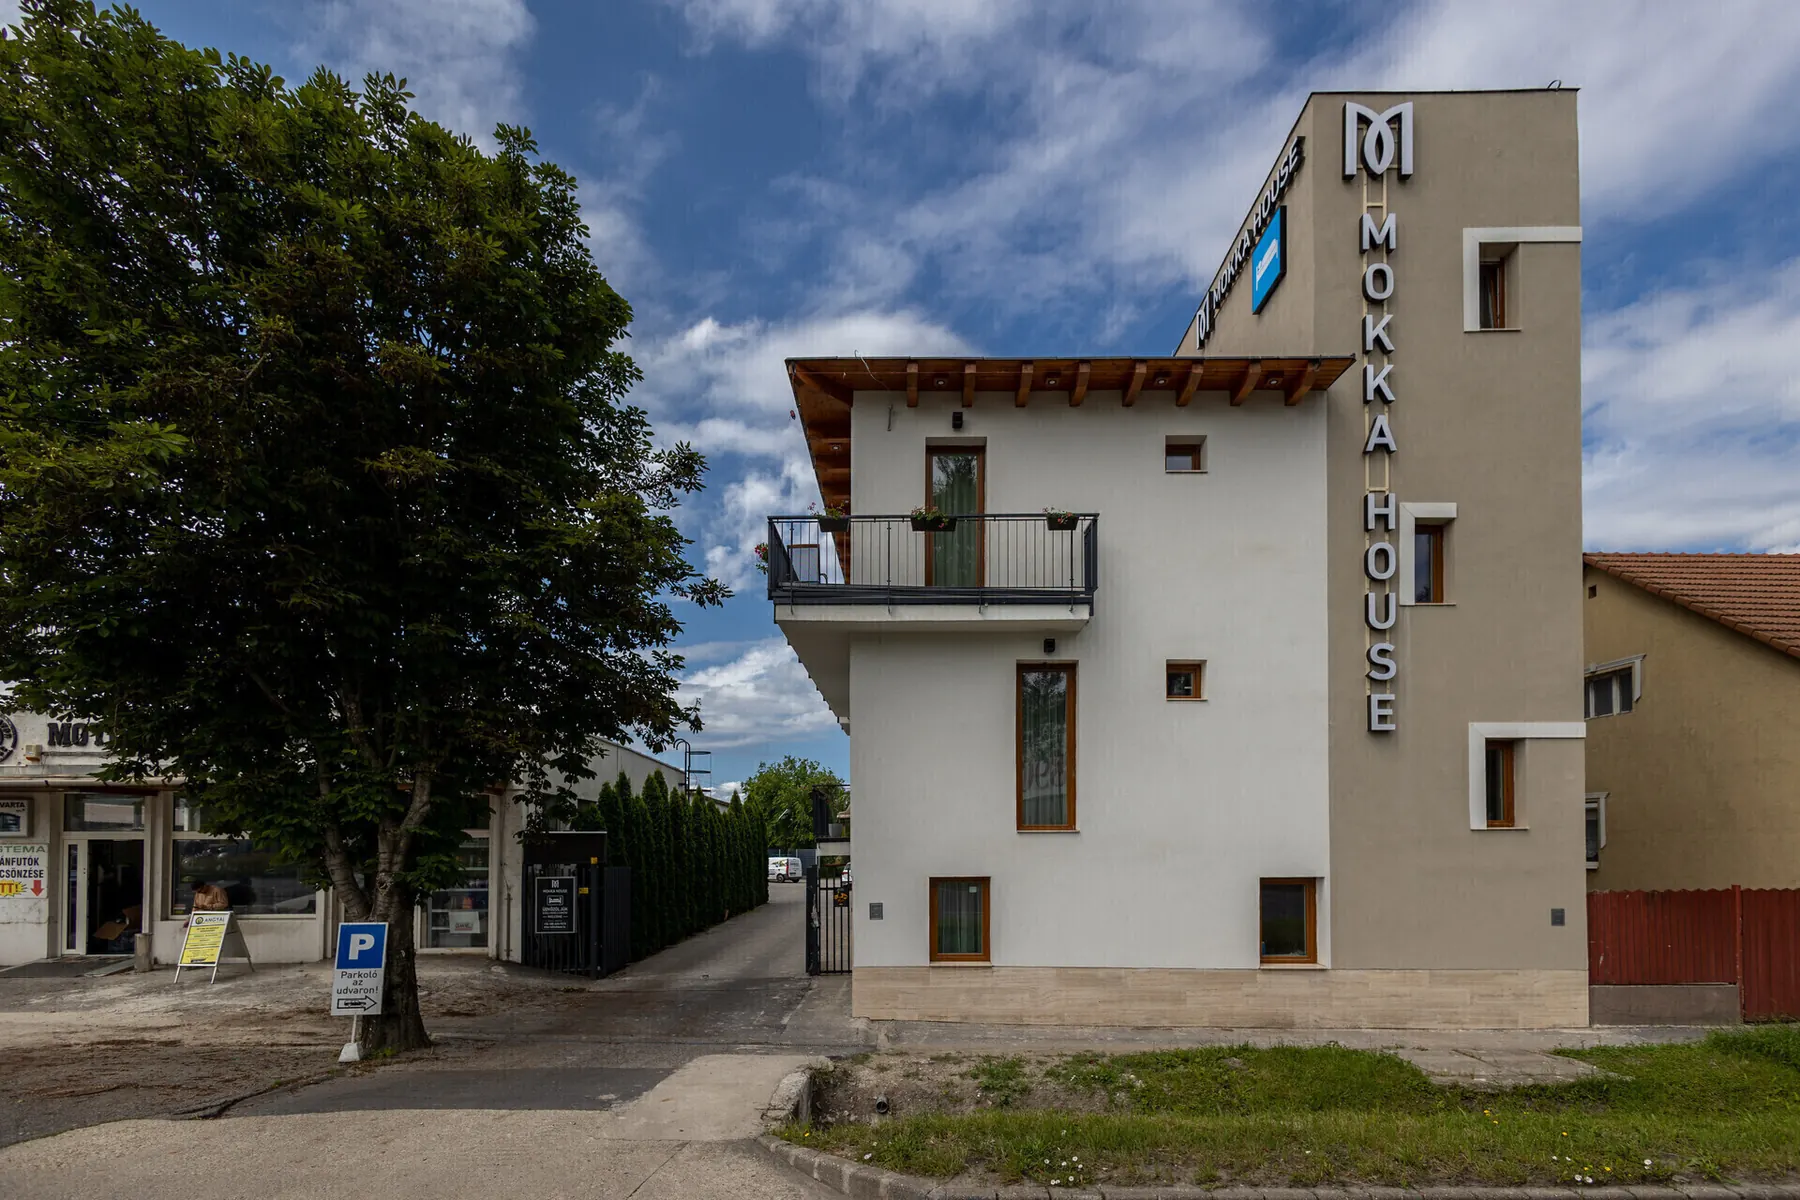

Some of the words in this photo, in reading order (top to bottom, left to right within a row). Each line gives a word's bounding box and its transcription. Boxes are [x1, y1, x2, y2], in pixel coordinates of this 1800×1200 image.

[1212, 229, 1254, 312] MOKKA
[1253, 136, 1306, 237] HOUSE
[1360, 212, 1397, 454] MOKKA
[1364, 493, 1398, 732] HOUSE
[336, 986, 379, 995] udvaron!
[340, 970, 378, 979] Parkoló
[348, 933, 375, 960] P
